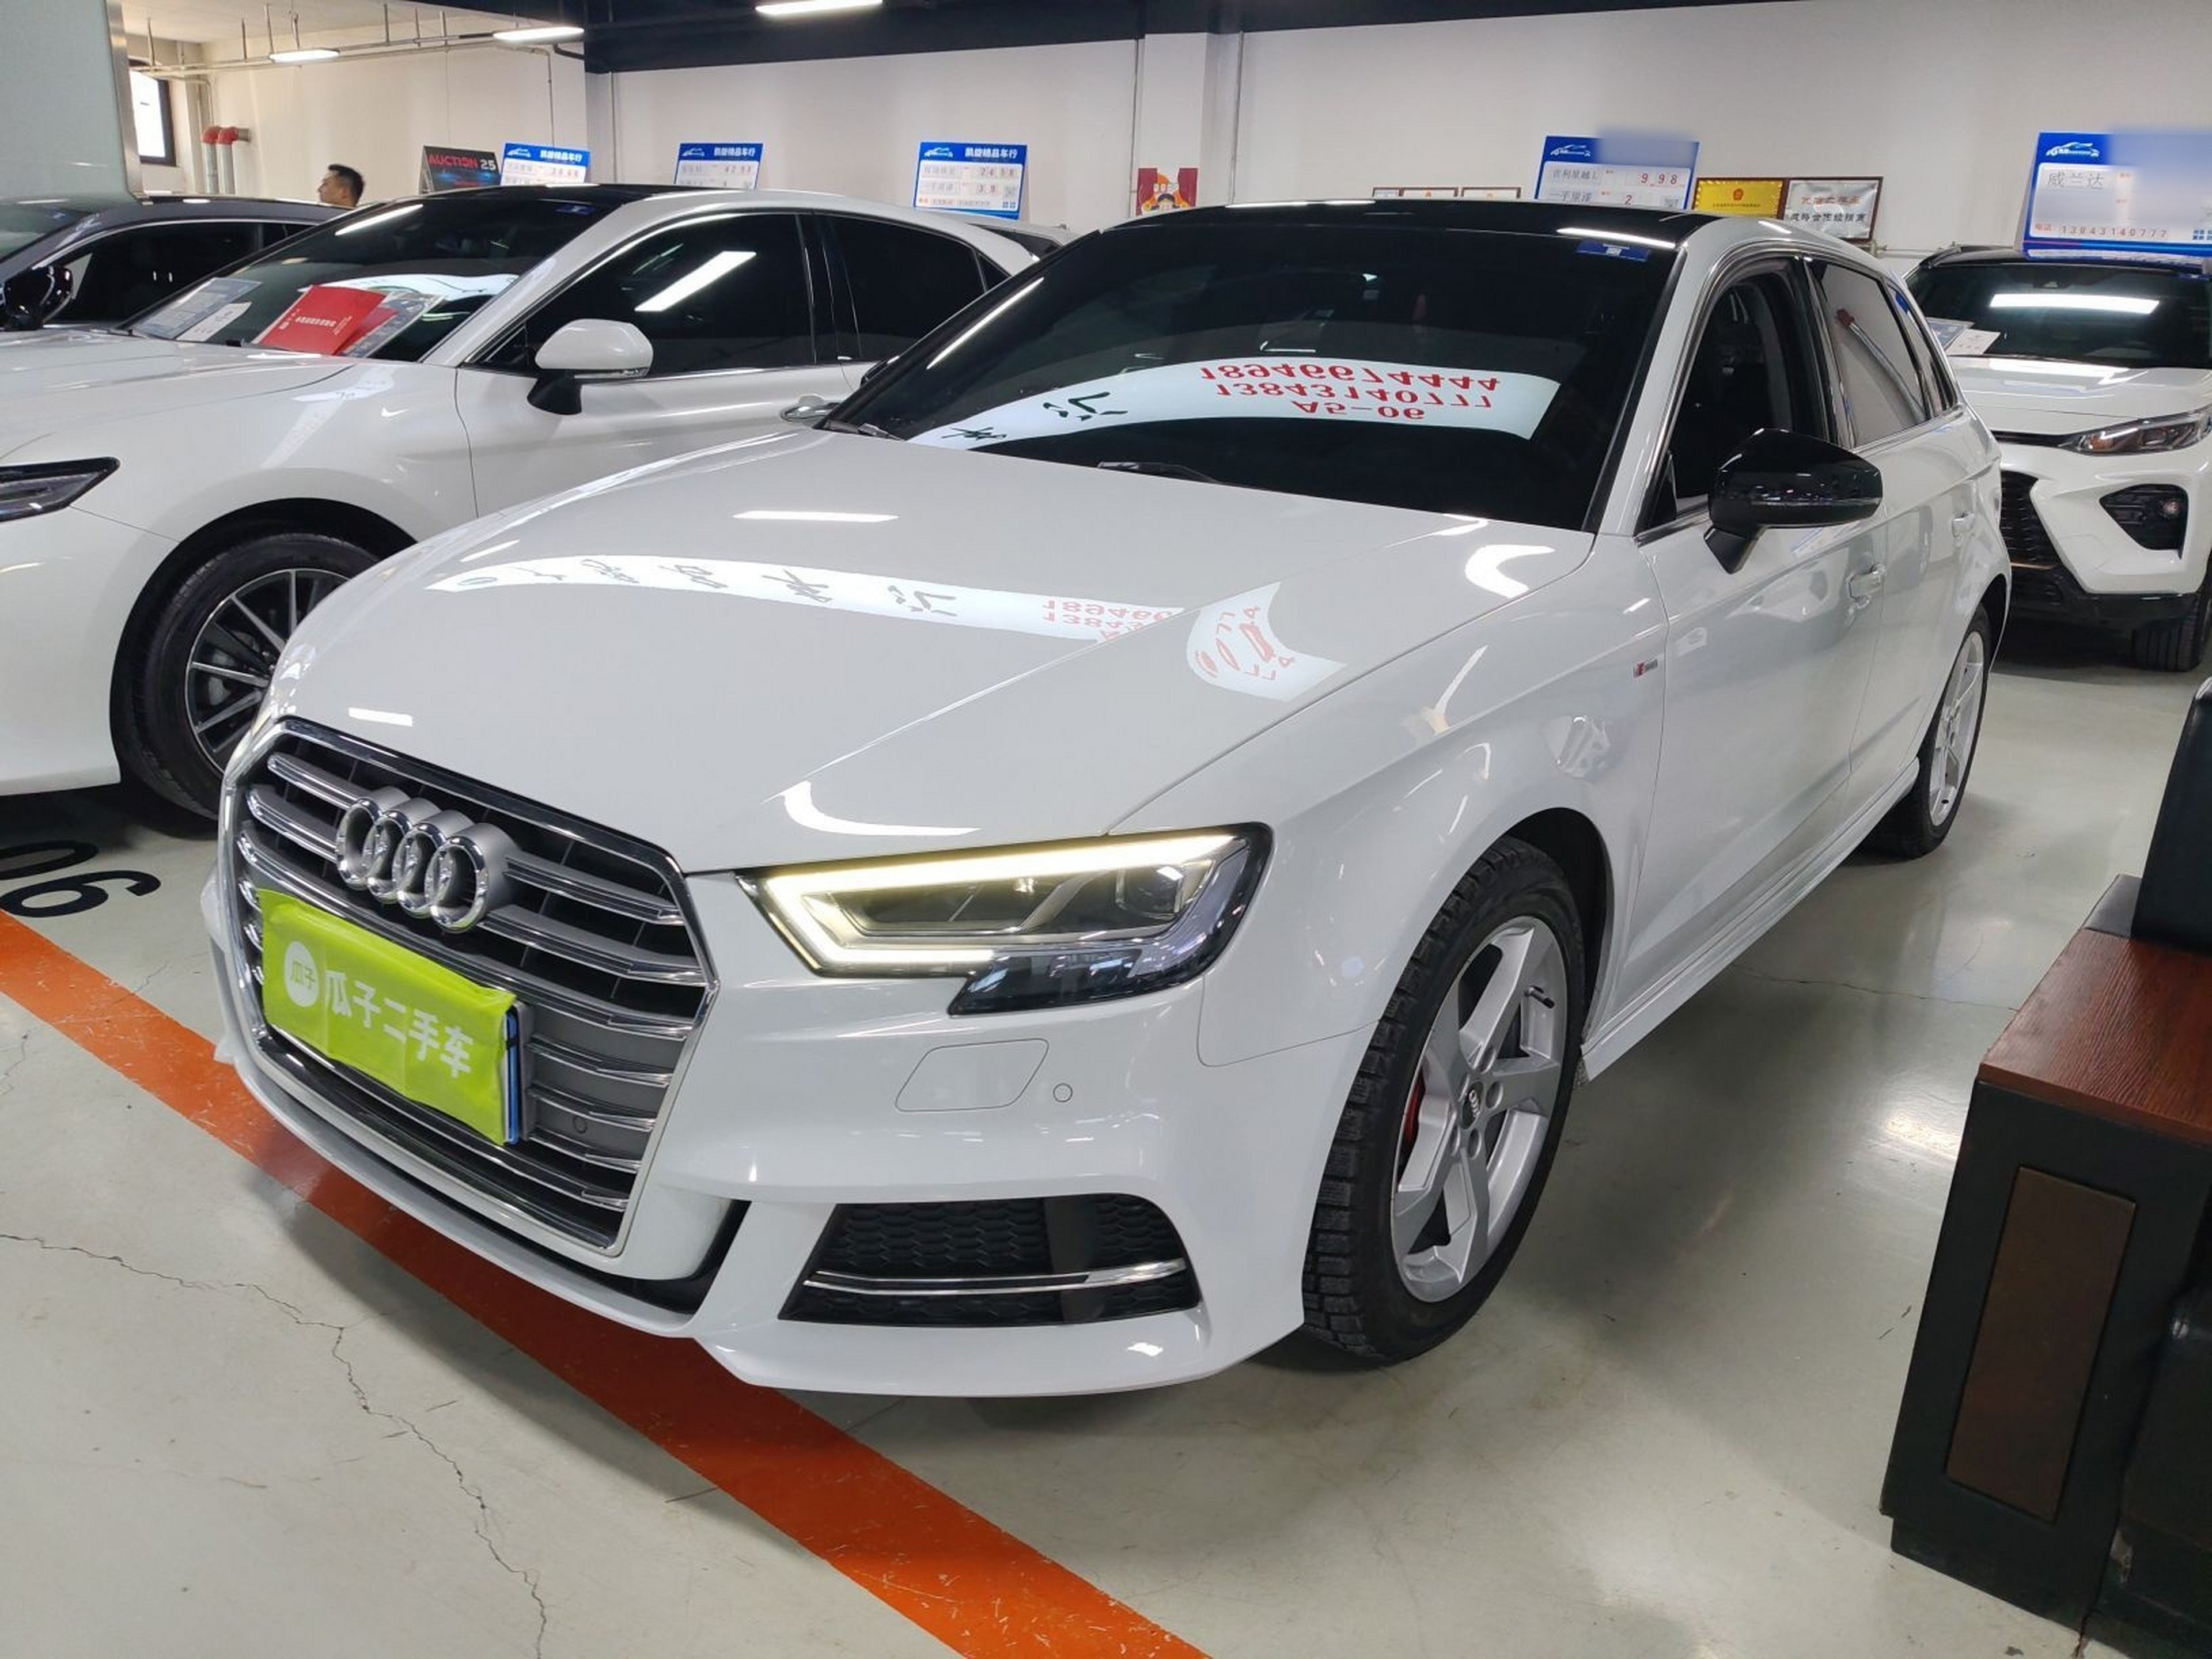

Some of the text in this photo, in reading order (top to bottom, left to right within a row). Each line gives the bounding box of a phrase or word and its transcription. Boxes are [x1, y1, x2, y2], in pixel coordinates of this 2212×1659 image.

[429, 153, 478, 168] AUCTION
[480, 159, 495, 170] 25
[2047, 171, 2104, 189] 威兰达
[325, 969, 475, 1079] 瓜子二手车
